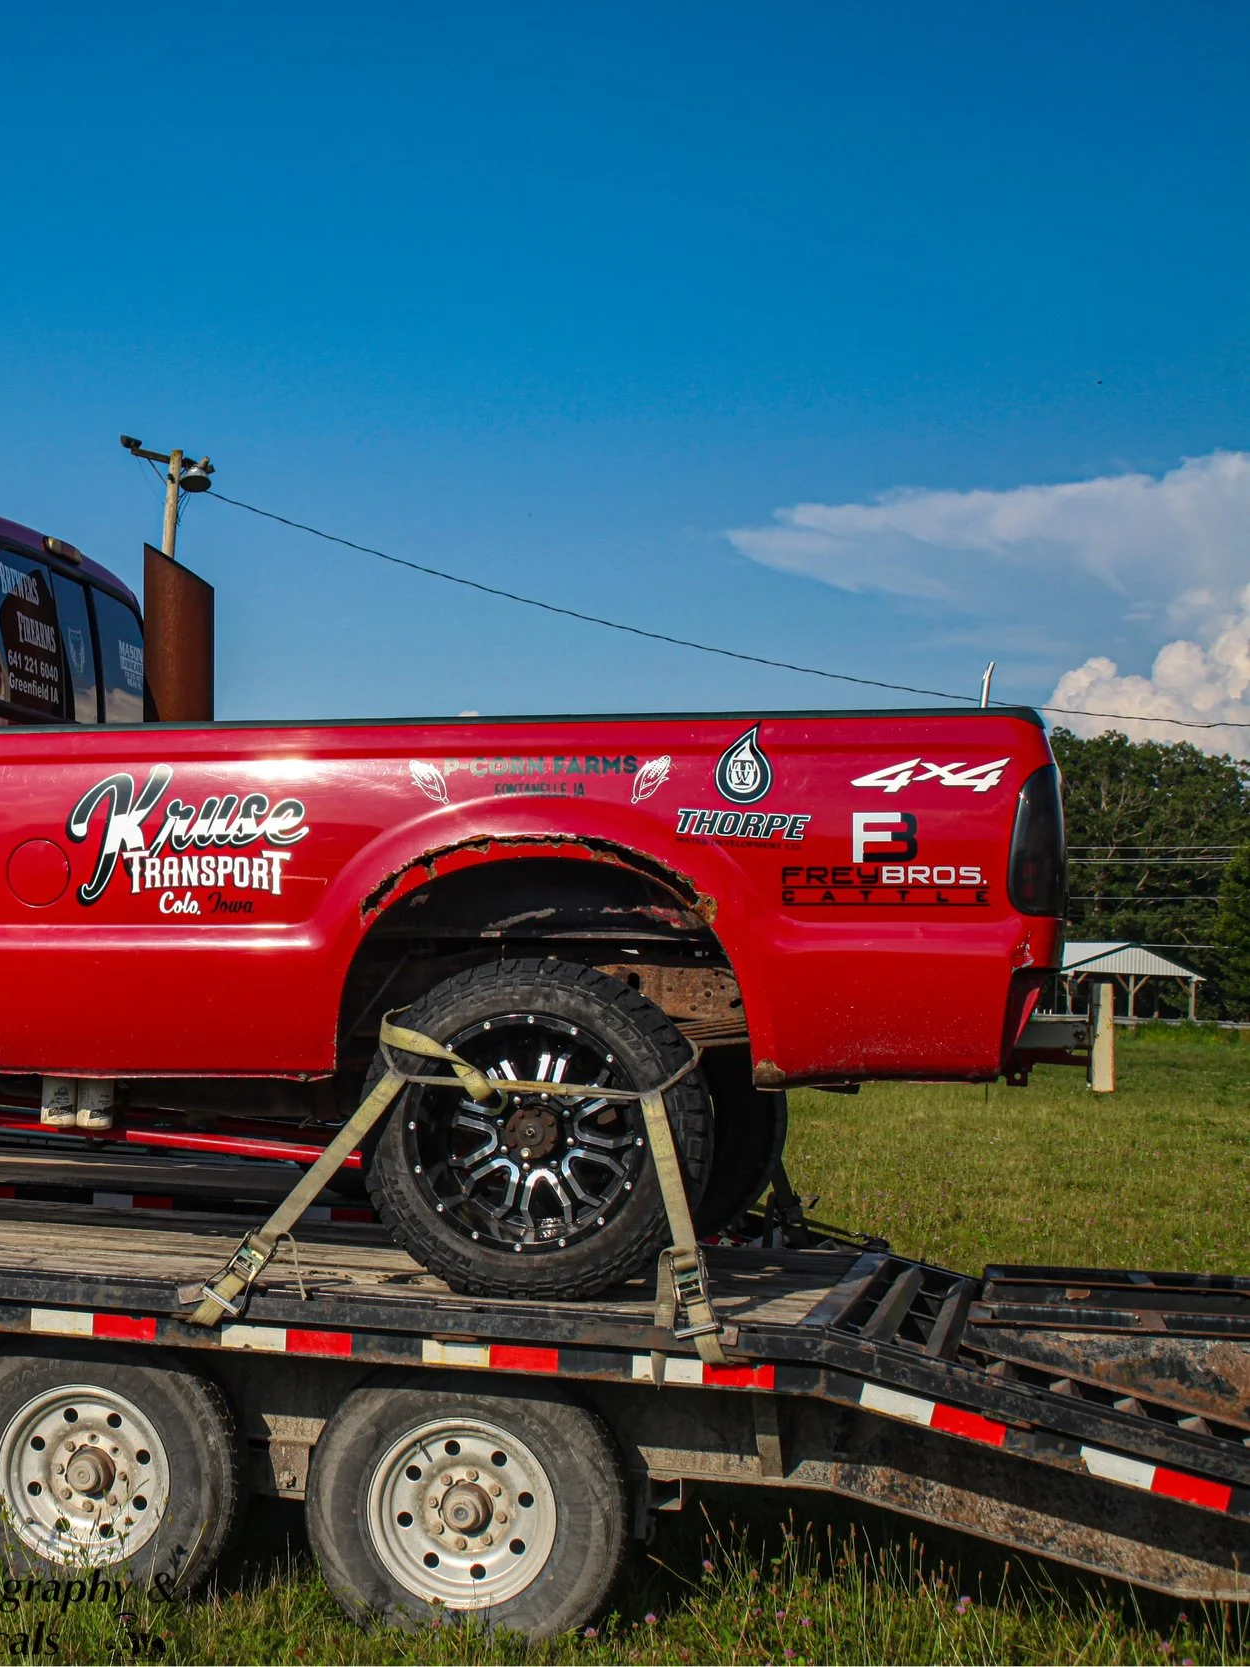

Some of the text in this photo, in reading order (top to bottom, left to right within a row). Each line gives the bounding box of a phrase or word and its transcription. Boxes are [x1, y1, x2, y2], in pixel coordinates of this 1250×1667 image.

[16, 611, 57, 653] FIREARMS
[7, 649, 59, 683] 641 221 6040
[8, 671, 60, 705] Greenfield IA
[443, 755, 639, 777] P-CORN FARMS
[572, 782, 586, 797] IA
[66, 763, 310, 907] Kruse
[676, 808, 812, 841] THORPE
[122, 850, 292, 895] TRANSPORT
[207, 891, 255, 915] Iowa
